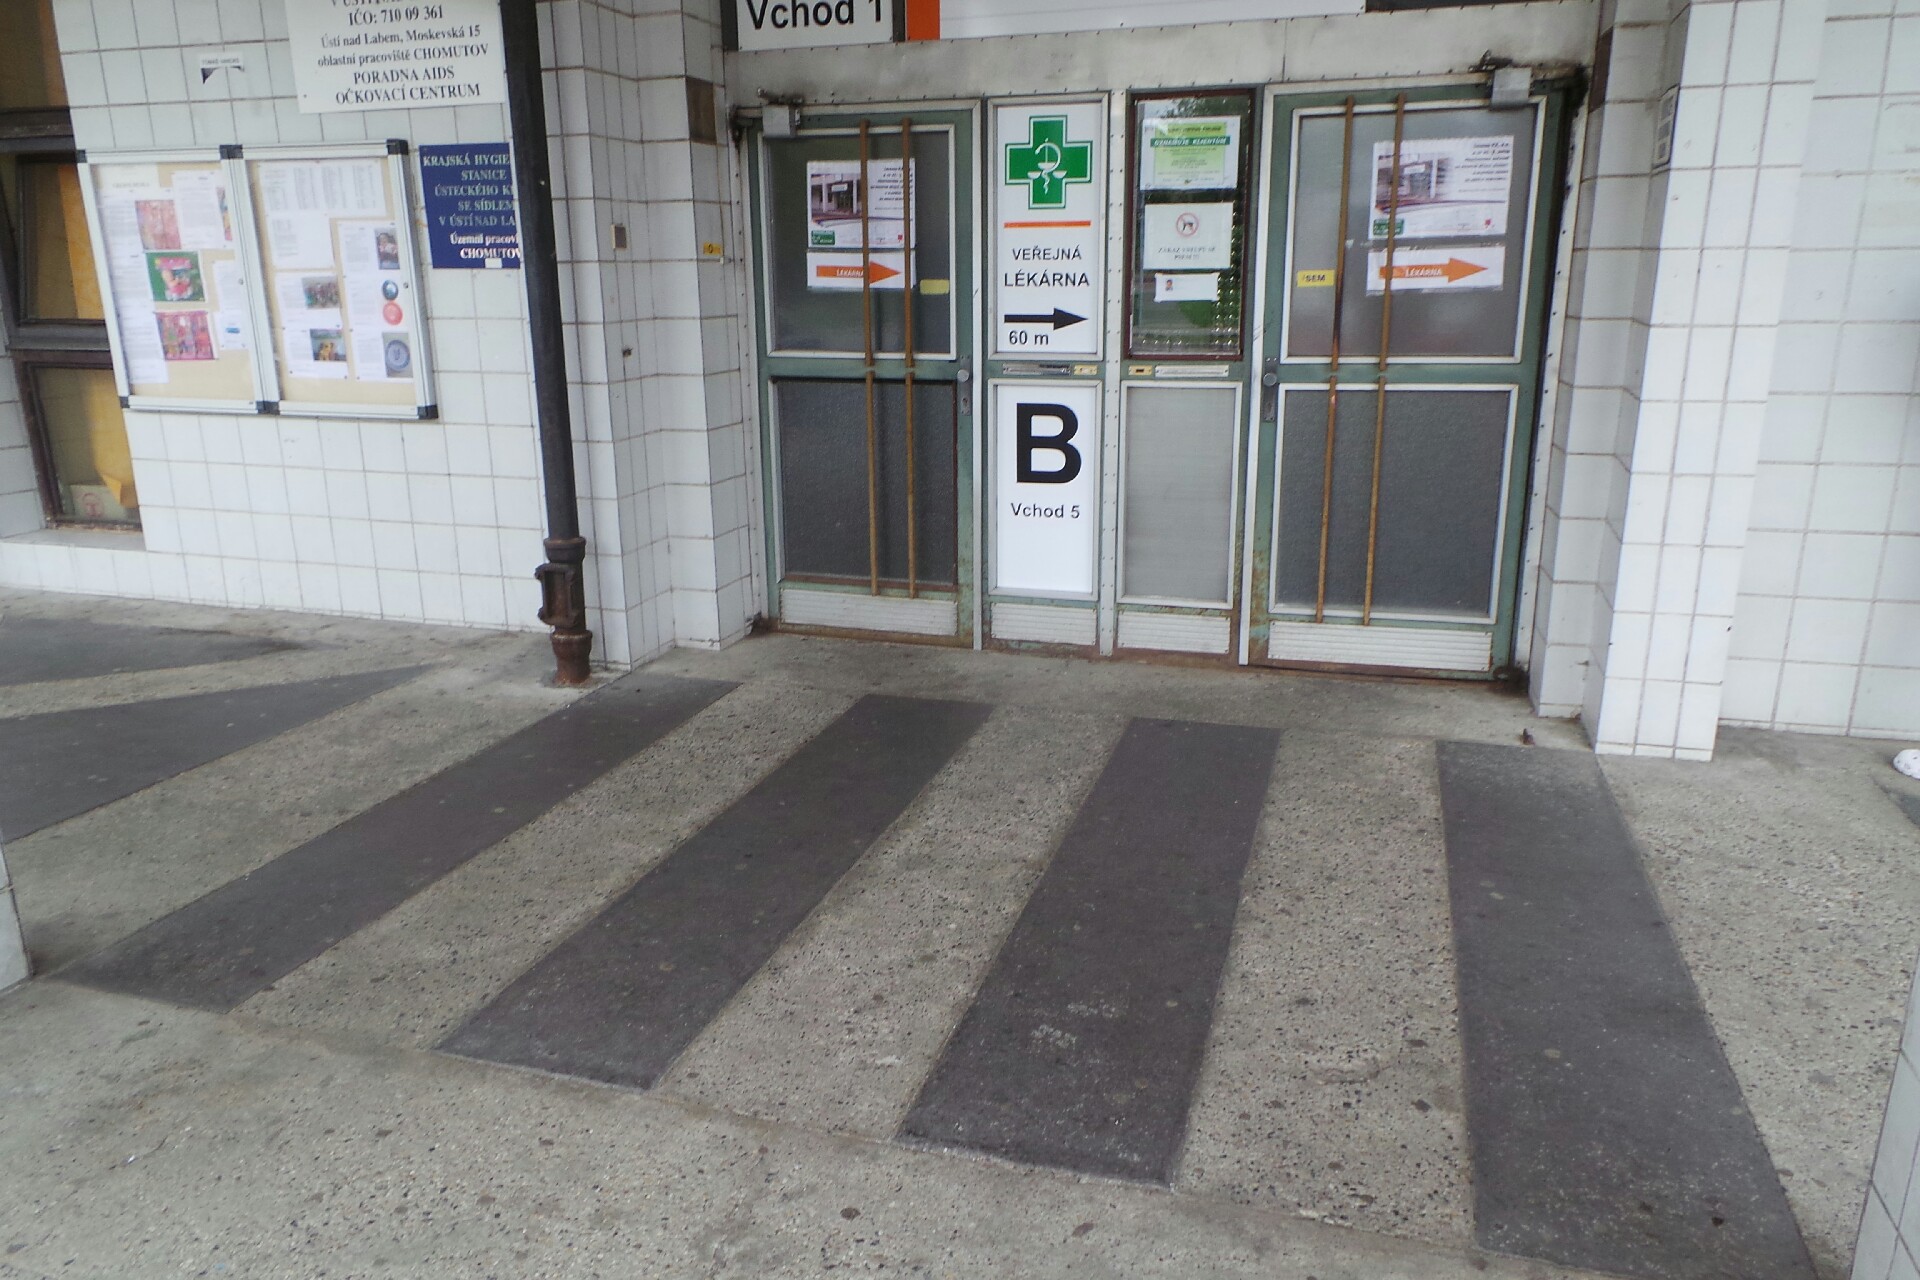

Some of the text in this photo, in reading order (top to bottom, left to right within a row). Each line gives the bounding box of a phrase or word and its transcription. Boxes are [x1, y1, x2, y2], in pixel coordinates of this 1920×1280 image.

[349, 5, 443, 26] IČO: 710 09 361
[746, 0, 882, 30] Vchod 1
[320, 24, 481, 48] Ústí nad Labem, Moskevská 15
[318, 43, 489, 68] oblastní pracoviště CHOMUTOV
[354, 65, 455, 85] PORADNA AIDS
[336, 83, 481, 105] OČKOVACÍ CENTRUM
[423, 153, 471, 167] KRAJSKÁ
[461, 169, 507, 181] STANICE
[434, 182, 499, 197] ÚSTECKÉHO
[458, 200, 472, 211] SE
[439, 216, 446, 226] V
[450, 213, 474, 226] ÚSTÍ
[474, 215, 497, 226] NAD
[450, 231, 483, 245] Územní
[1012, 244, 1082, 261] VEŘEJNÁ
[1004, 268, 1090, 288] LÉKÁRNA
[1009, 330, 1049, 345] 60 m
[1016, 402, 1082, 484] B
[1010, 502, 1080, 519] Vchod 5
